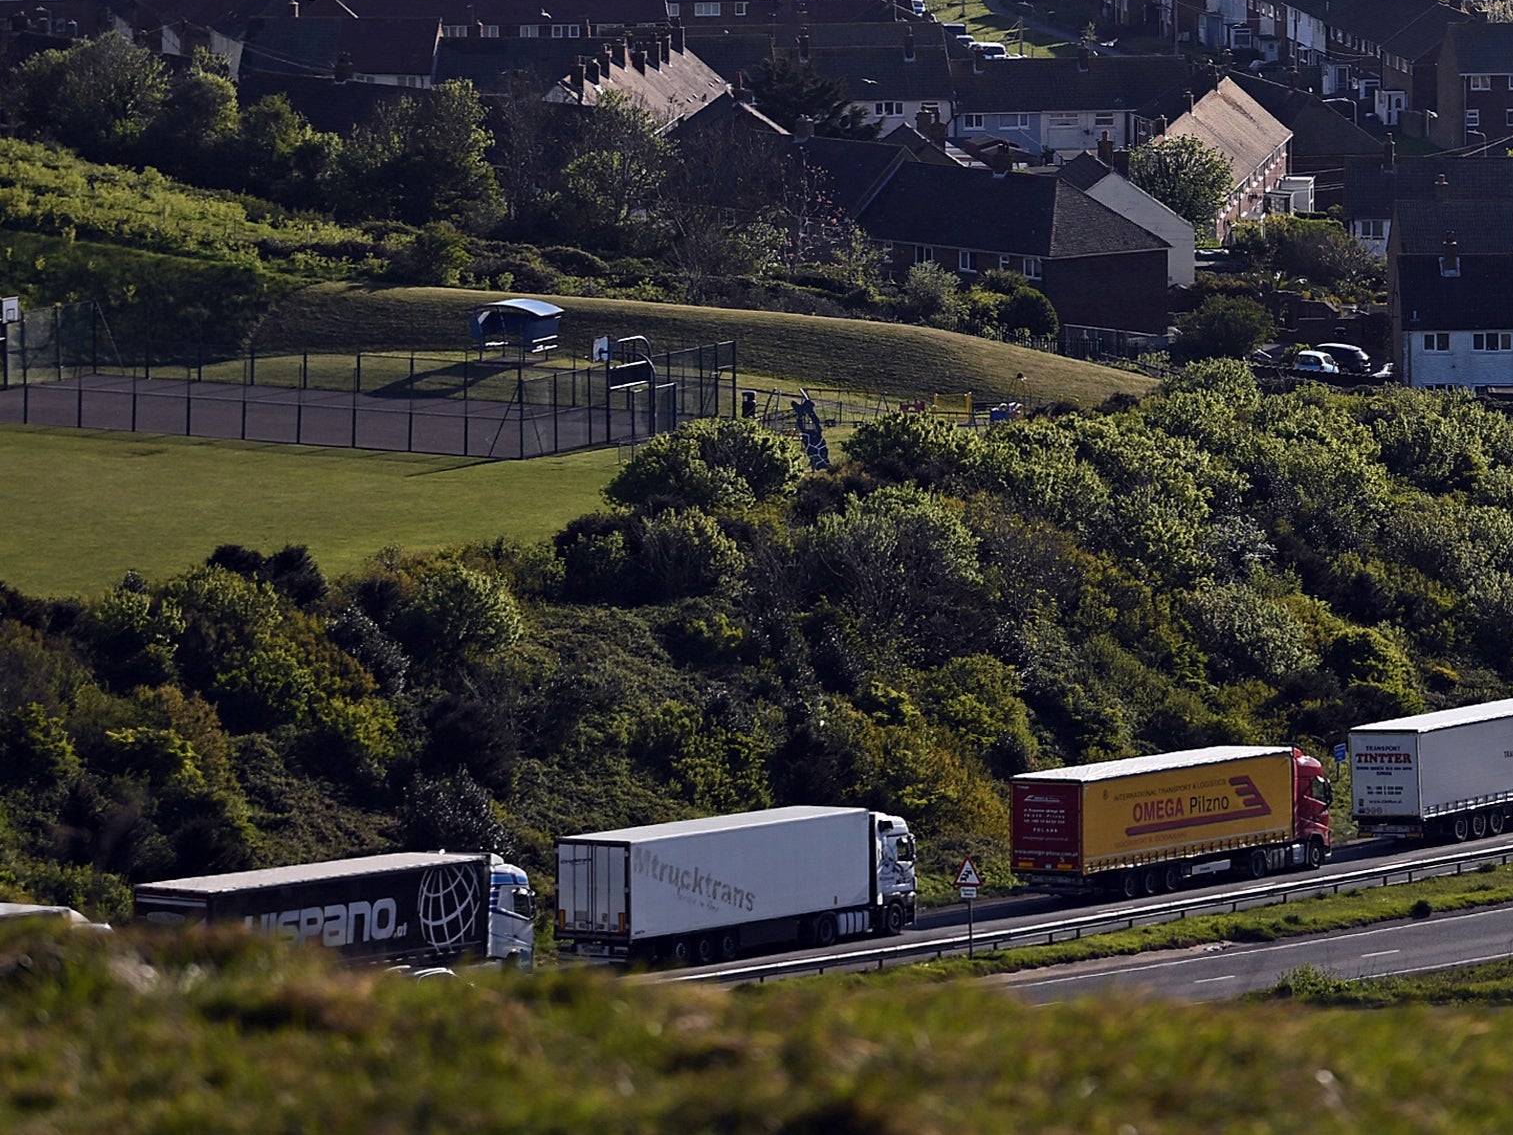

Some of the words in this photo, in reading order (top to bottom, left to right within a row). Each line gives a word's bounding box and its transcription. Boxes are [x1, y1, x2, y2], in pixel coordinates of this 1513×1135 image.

[1355, 752, 1412, 764] TINTTER
[1113, 788, 1158, 802] INTERNATIONAL
[1158, 784, 1191, 796] TRANSPORT
[1132, 796, 1184, 823] OMEGA
[1189, 795, 1230, 815] Pilzno
